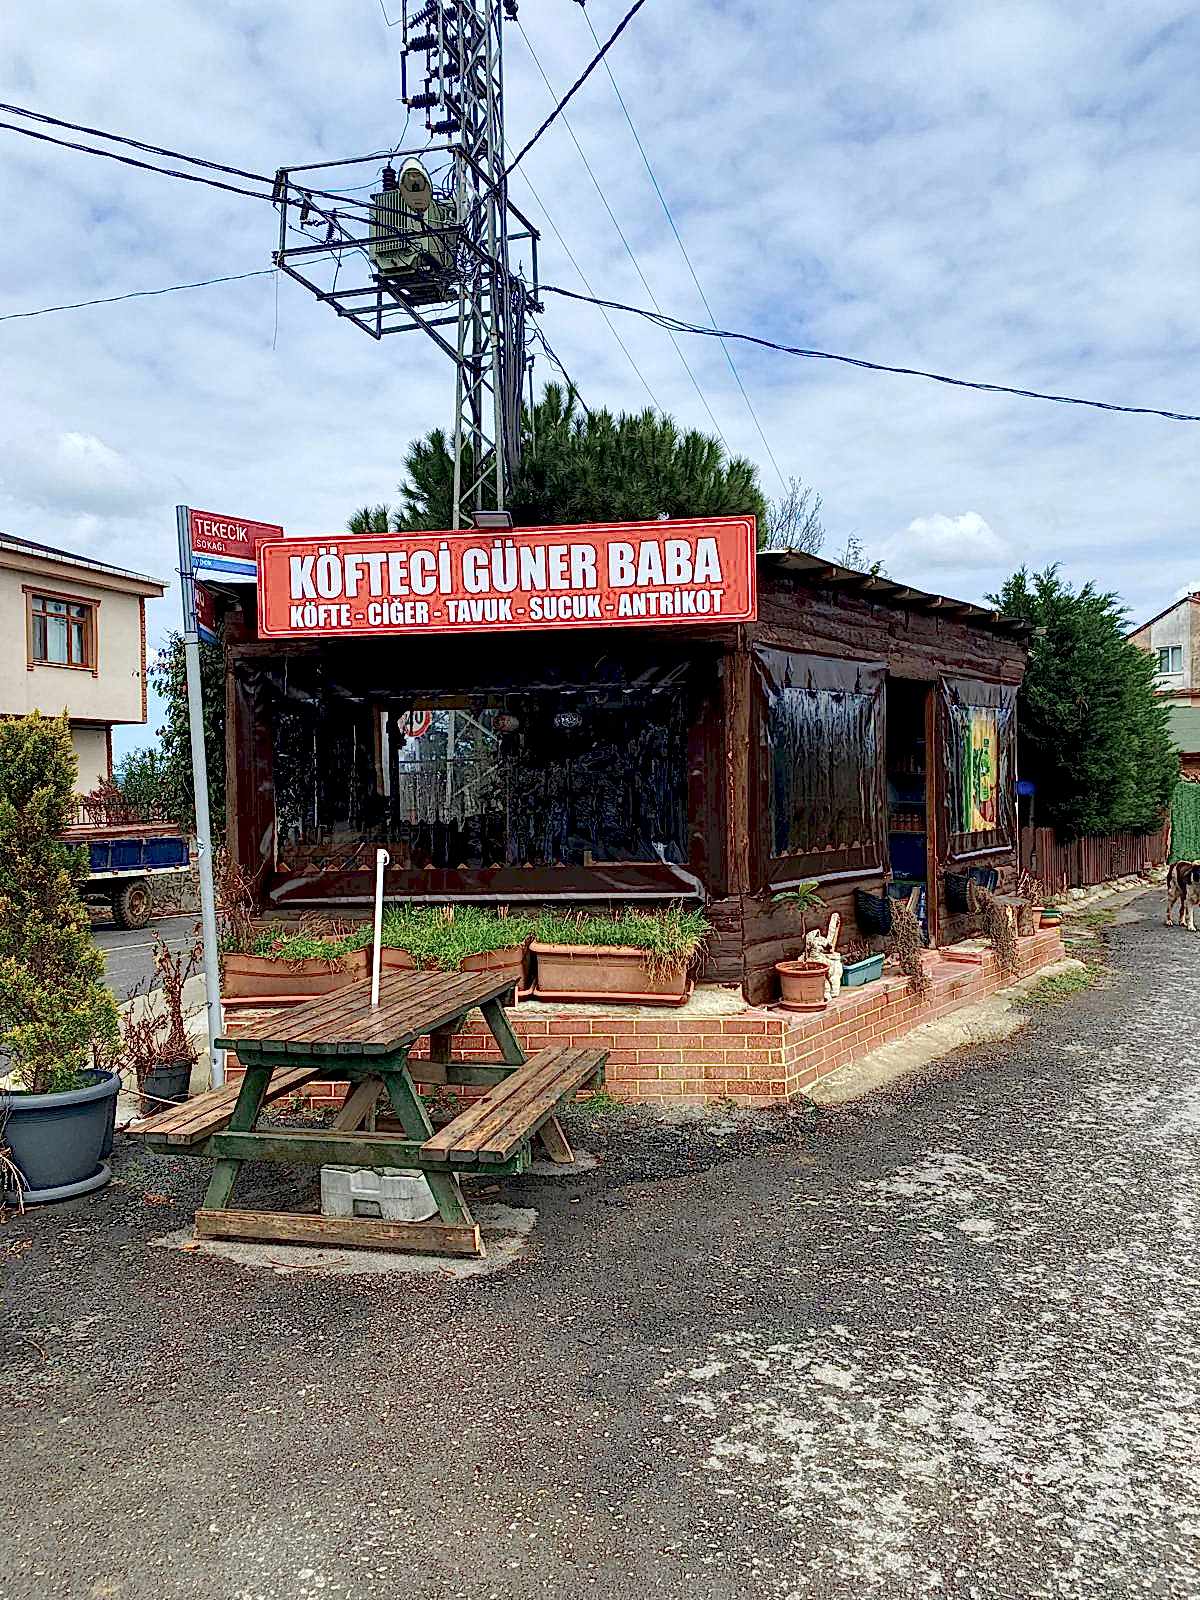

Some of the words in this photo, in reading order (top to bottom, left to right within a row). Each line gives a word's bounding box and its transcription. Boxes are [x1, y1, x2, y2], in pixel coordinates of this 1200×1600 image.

[195, 519, 249, 543] TEKECİK
[289, 541, 452, 600] KÖFTECİ
[462, 539, 598, 593] GÜNER
[608, 537, 723, 588] BABA
[290, 602, 351, 628] KÖFTE
[368, 598, 429, 626] CİĞER
[446, 598, 513, 623] TAVUK
[529, 594, 602, 620] SUCUK
[618, 587, 724, 617] ANTRİKOT
